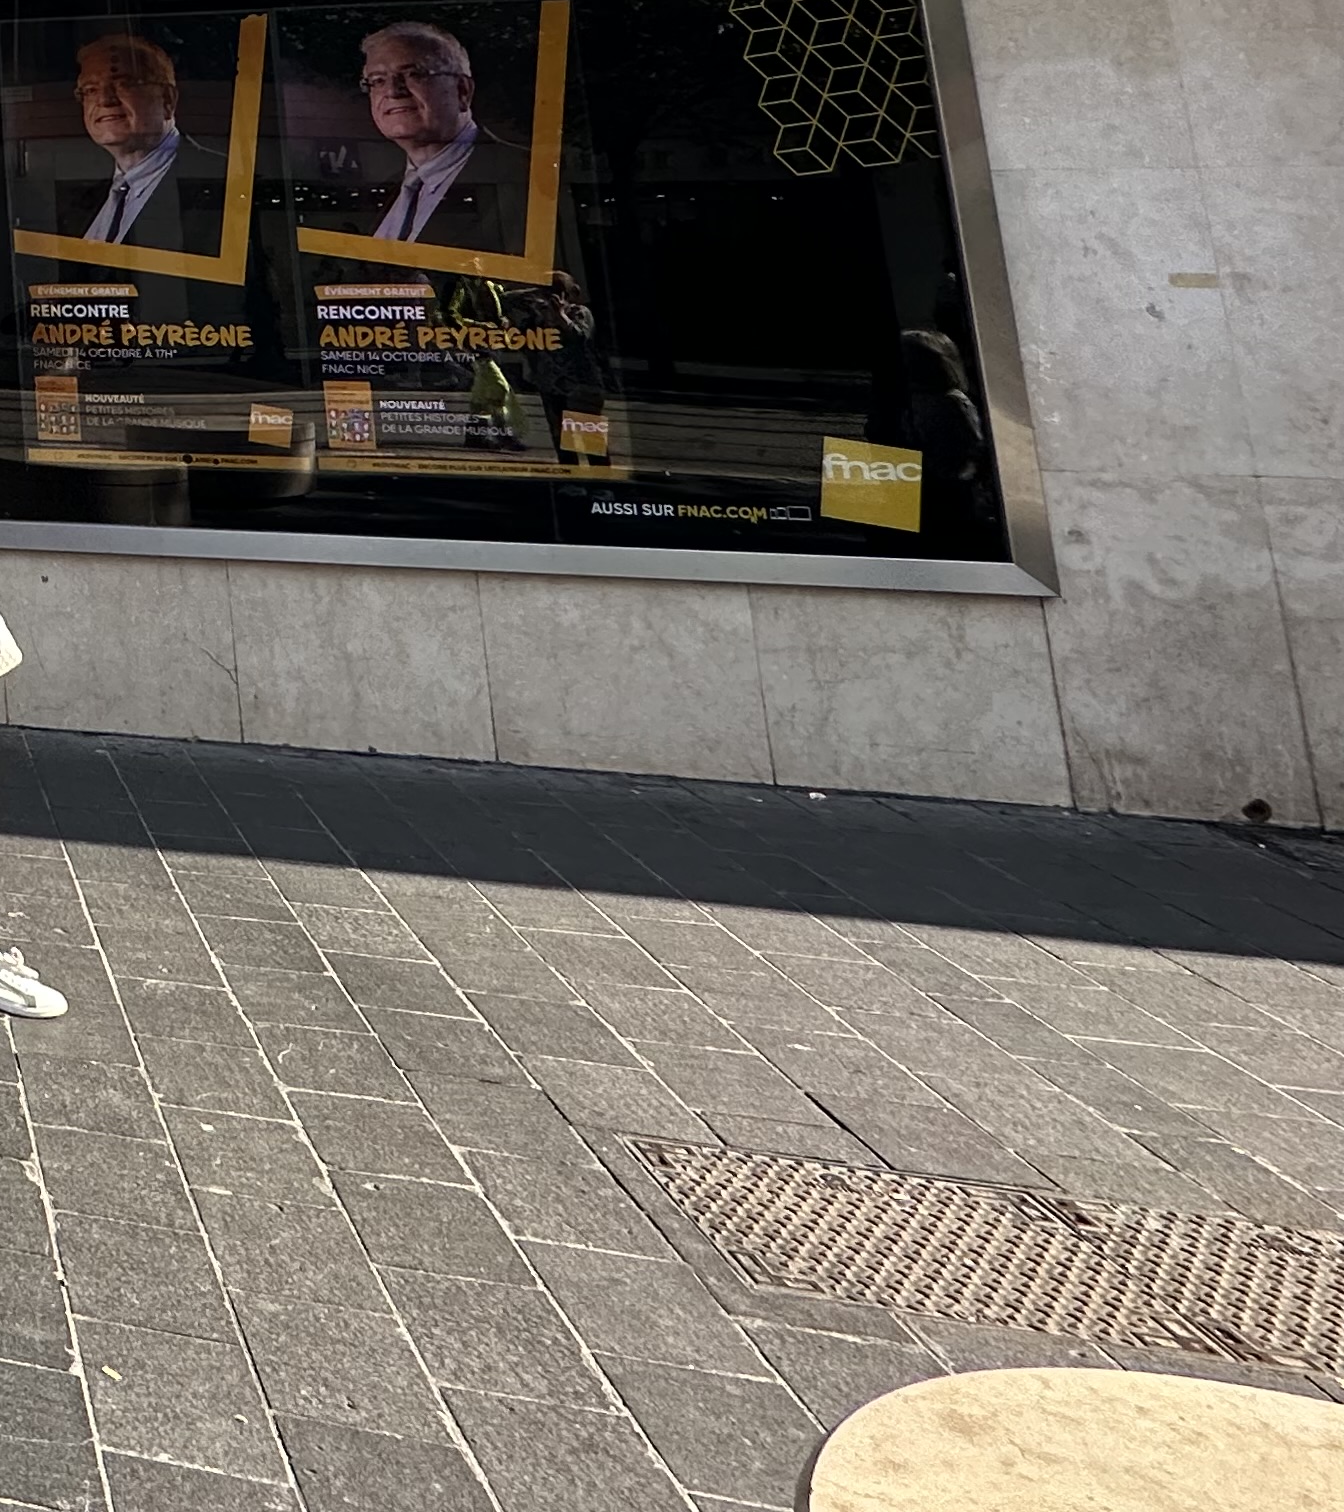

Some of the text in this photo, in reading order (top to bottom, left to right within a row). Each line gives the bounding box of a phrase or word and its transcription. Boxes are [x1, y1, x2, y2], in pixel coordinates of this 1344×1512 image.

[383, 287, 426, 296] GRATUIT
[30, 303, 130, 318] RENCONTRE
[316, 305, 426, 320] RENCONTRE
[31, 319, 253, 346] ANDRÉ PEYRÈGNE
[318, 322, 411, 350] ANDRÉ
[88, 349, 142, 358] OCTOBRE
[145, 347, 153, 358] À
[320, 350, 364, 361] SAMEDI
[367, 351, 381, 361] 14
[384, 351, 441, 362] OCTOBRE
[444, 350, 453, 362] À
[33, 360, 64, 369] FNAC
[322, 363, 385, 375] FNAC NICE
[85, 393, 145, 404] NOUVEAUTÉ
[379, 399, 446, 410] NOUVEAUTÉ
[250, 410, 293, 425] fnac
[380, 412, 479, 423] PETITES HISTOIRES
[382, 423, 513, 436] DE LA GRANDE MUSIQUE
[562, 417, 609, 433] fnac
[823, 452, 922, 483] fnac
[591, 501, 768, 520] AUSSI SUR FNAC.COM
